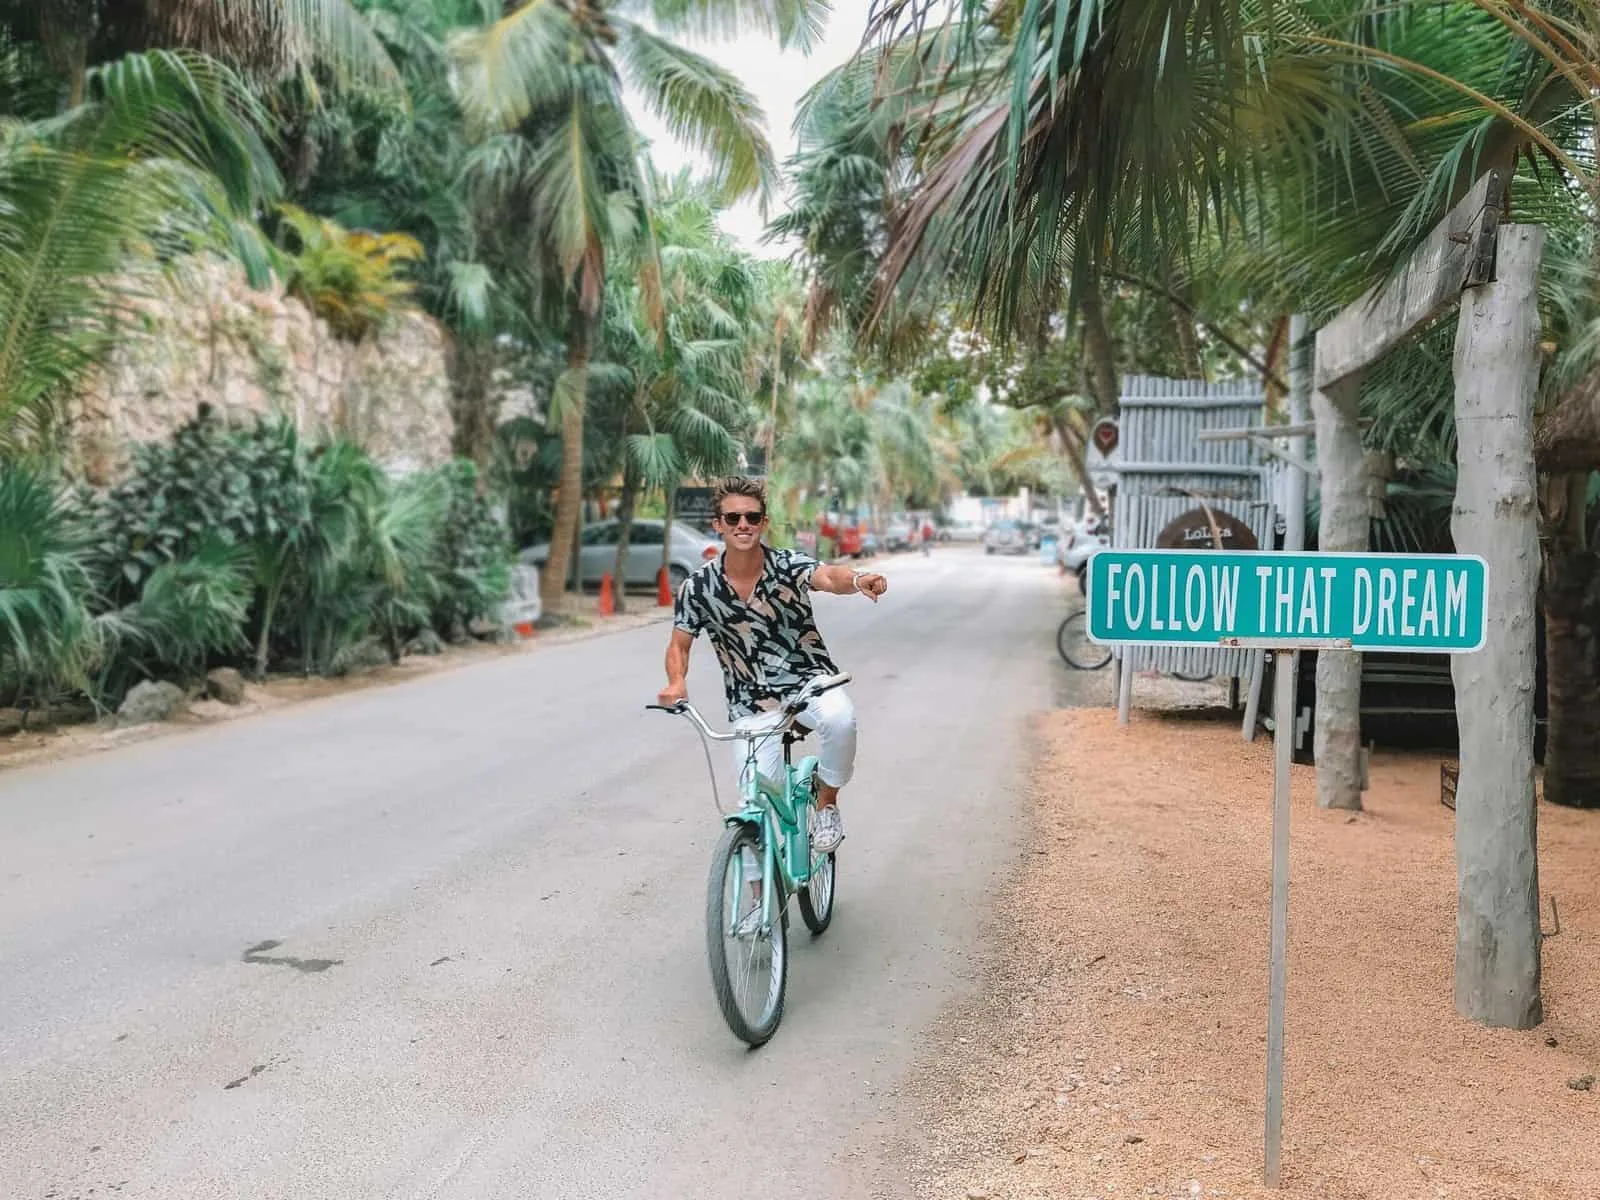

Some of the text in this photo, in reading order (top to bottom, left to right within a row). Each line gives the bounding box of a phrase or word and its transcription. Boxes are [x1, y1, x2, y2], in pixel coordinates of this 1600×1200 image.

[1184, 526, 1232, 541] LoLa
[1107, 563, 1468, 637] FOLLOW THAT DREAM
